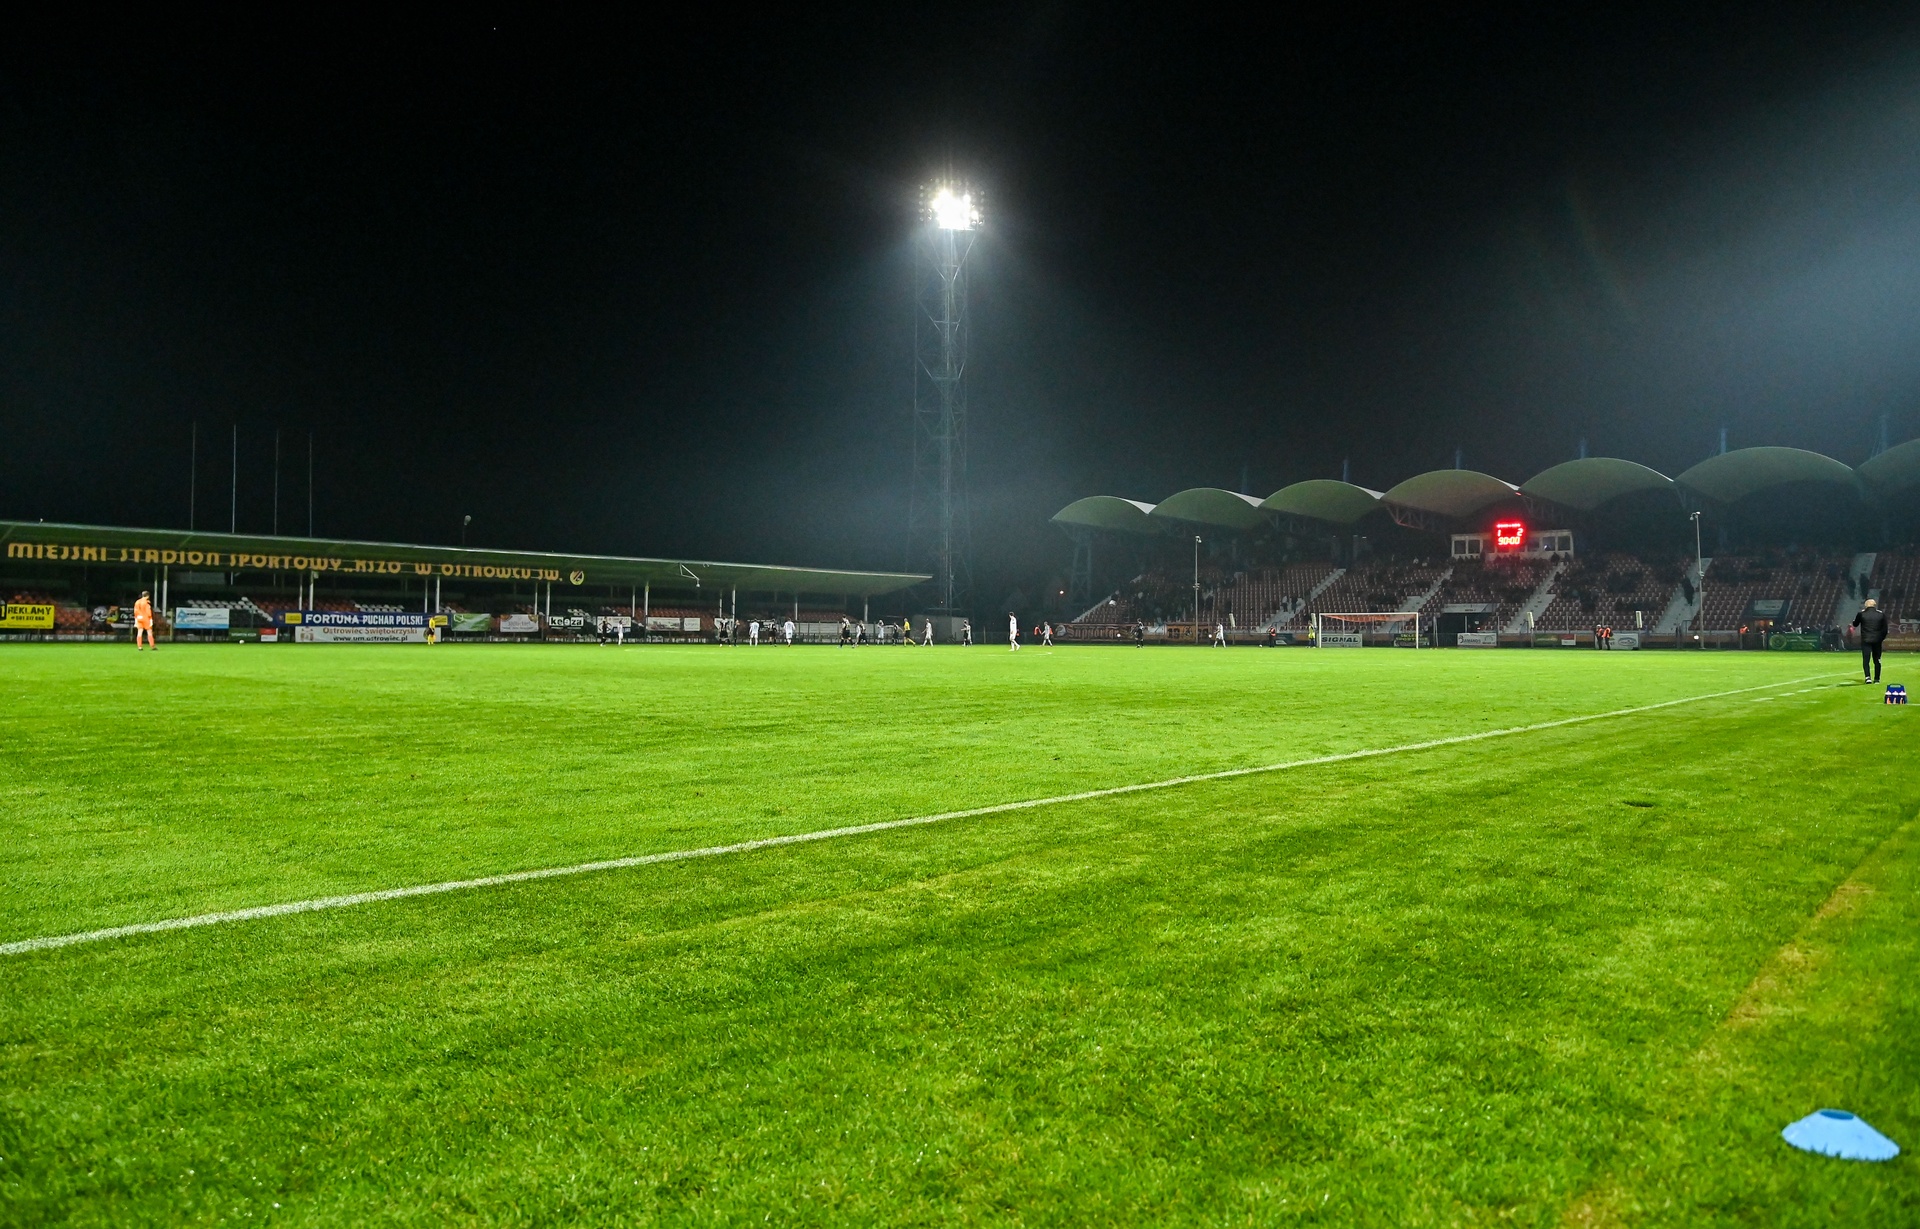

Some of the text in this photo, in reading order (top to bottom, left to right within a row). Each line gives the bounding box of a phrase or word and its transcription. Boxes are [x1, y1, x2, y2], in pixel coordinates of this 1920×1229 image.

[1516, 527, 1524, 537] 2
[1497, 536, 1521, 546] 90:00
[7, 542, 107, 562] MIEJSKI
[119, 547, 220, 566] STADION
[229, 553, 342, 571] SPORTOWY
[414, 562, 432, 576] W
[440, 564, 531, 579] OSTROWCU
[8, 606, 52, 615] REKLAMY
[305, 613, 360, 625] FORTUNA
[362, 614, 395, 625] PUCHAR
[395, 615, 423, 625] POLSKI
